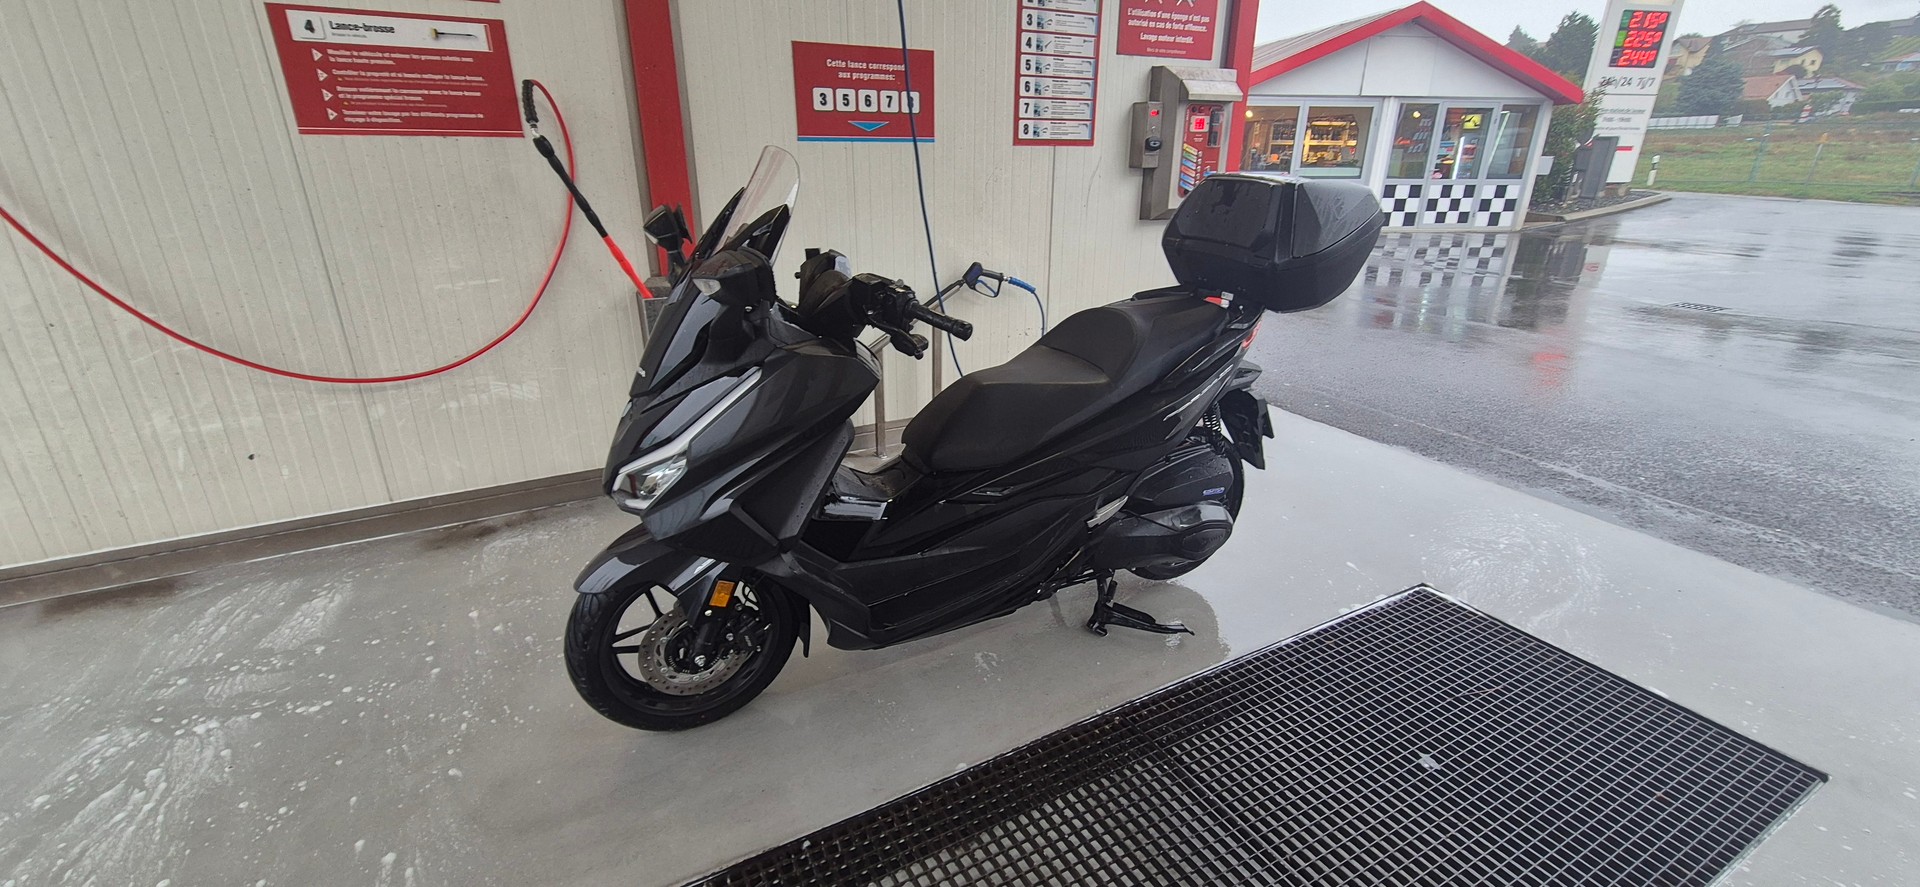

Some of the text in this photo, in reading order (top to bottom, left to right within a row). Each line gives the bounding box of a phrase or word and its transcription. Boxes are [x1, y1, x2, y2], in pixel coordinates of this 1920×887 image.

[1026, 13, 1033, 26] 3
[304, 19, 315, 34] 4
[329, 20, 395, 34] Lance-brosse
[1025, 37, 1032, 49] 4
[826, 59, 905, 72] Cette lance correspond
[1025, 59, 1031, 71] 5
[852, 73, 896, 81] programmes:
[1024, 81, 1031, 93] 6
[819, 93, 827, 106] 3
[842, 94, 850, 107] 5
[864, 94, 872, 107] 6
[886, 95, 893, 108] 7
[1024, 103, 1030, 114] 7
[1023, 124, 1029, 135] 8
